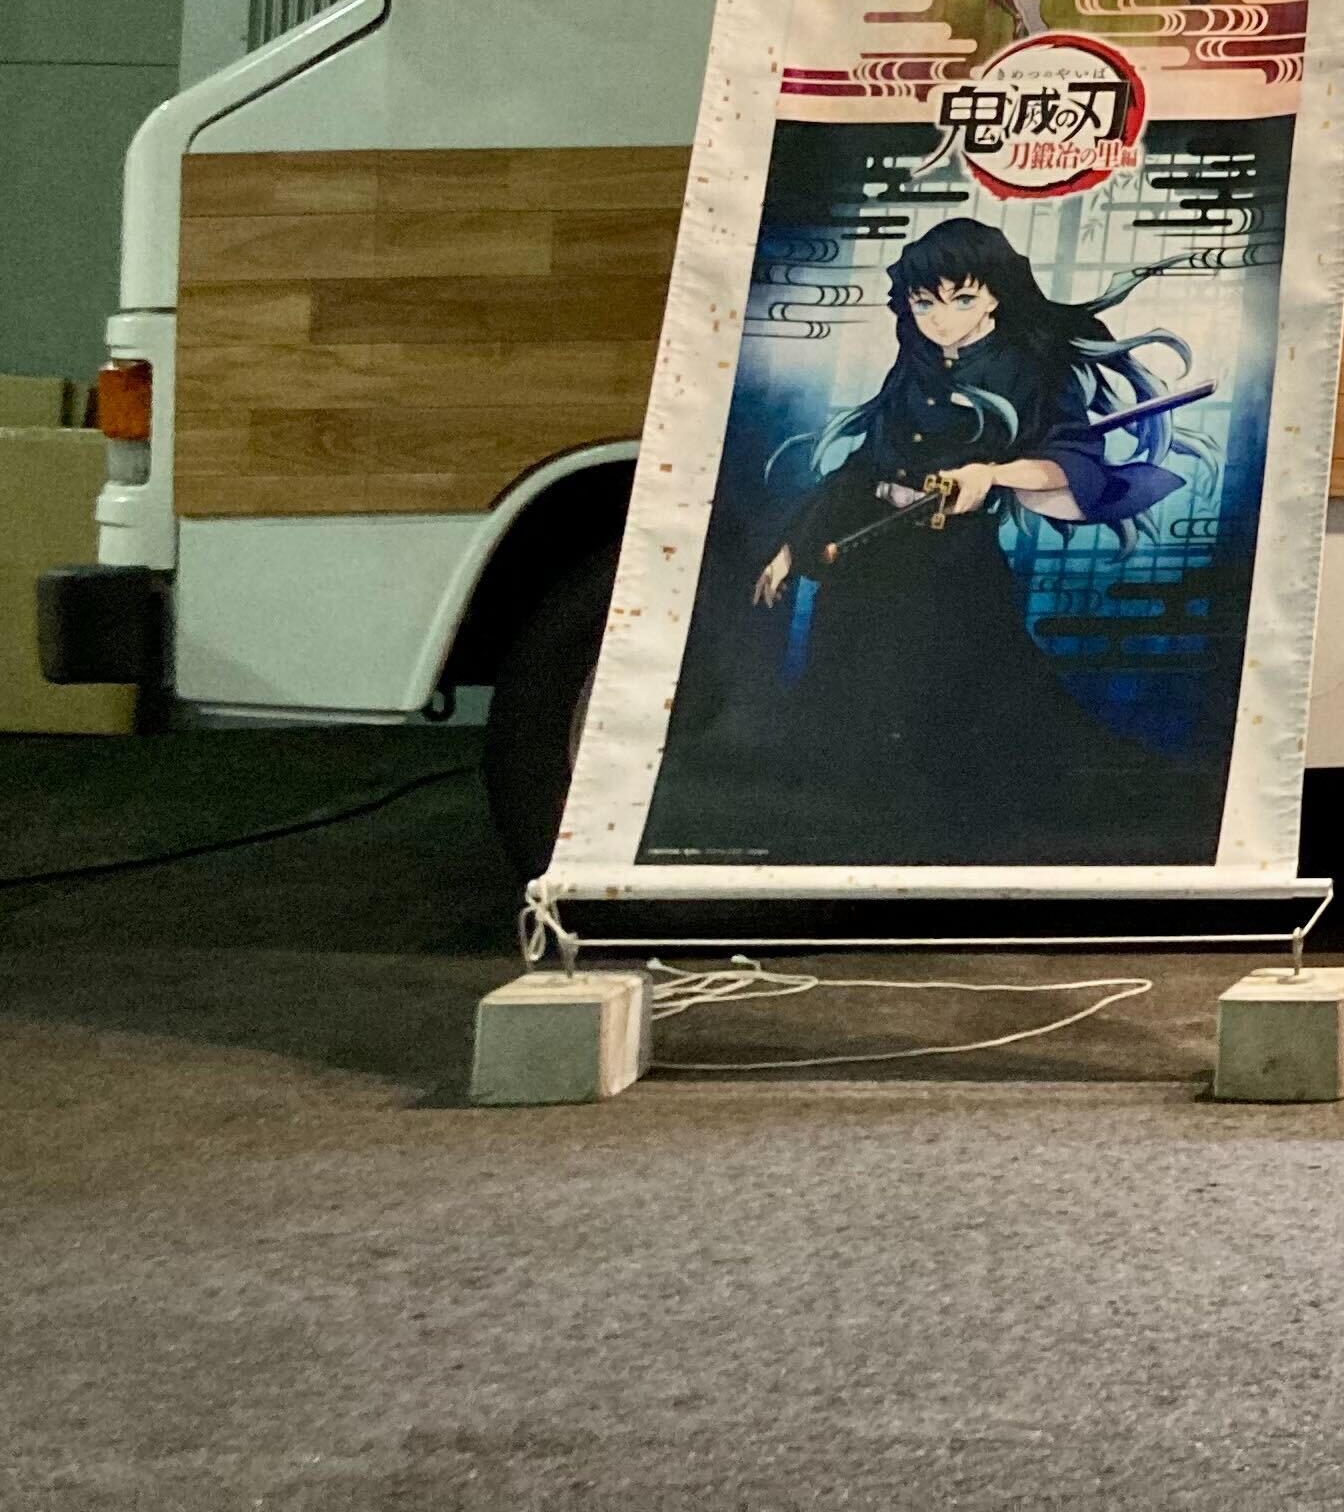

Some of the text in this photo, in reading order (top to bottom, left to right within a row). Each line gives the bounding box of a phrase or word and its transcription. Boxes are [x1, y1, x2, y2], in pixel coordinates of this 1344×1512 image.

[995, 66, 1109, 82] きめつのやいば
[914, 81, 1131, 174] 鬼滅の刃
[1008, 138, 1138, 171] 刀鍛冶の里編
